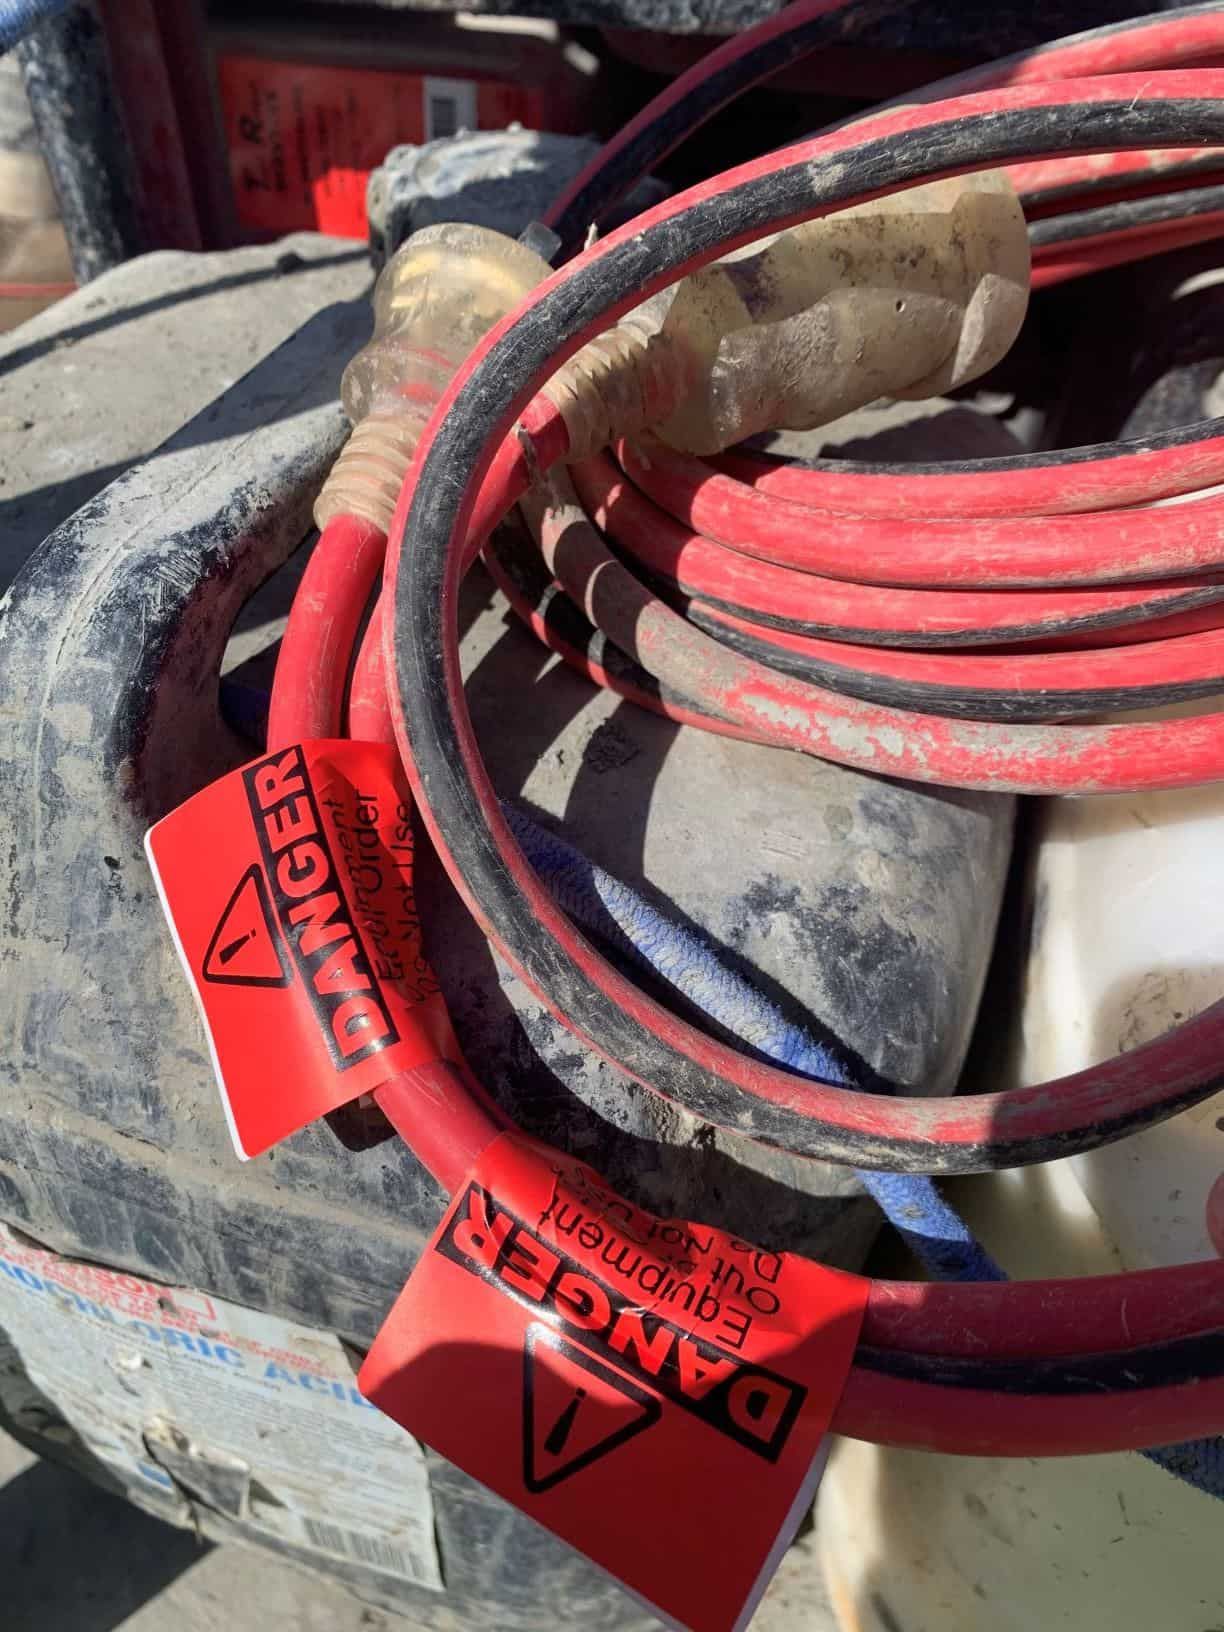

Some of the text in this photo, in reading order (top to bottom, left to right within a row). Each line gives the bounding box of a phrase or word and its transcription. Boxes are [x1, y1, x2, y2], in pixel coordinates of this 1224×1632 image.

[254, 749, 390, 1057] DANGER
[454, 1190, 794, 1444] DANGER
[534, 1196, 753, 1350] Equipment
[711, 1257, 781, 1315] Out
